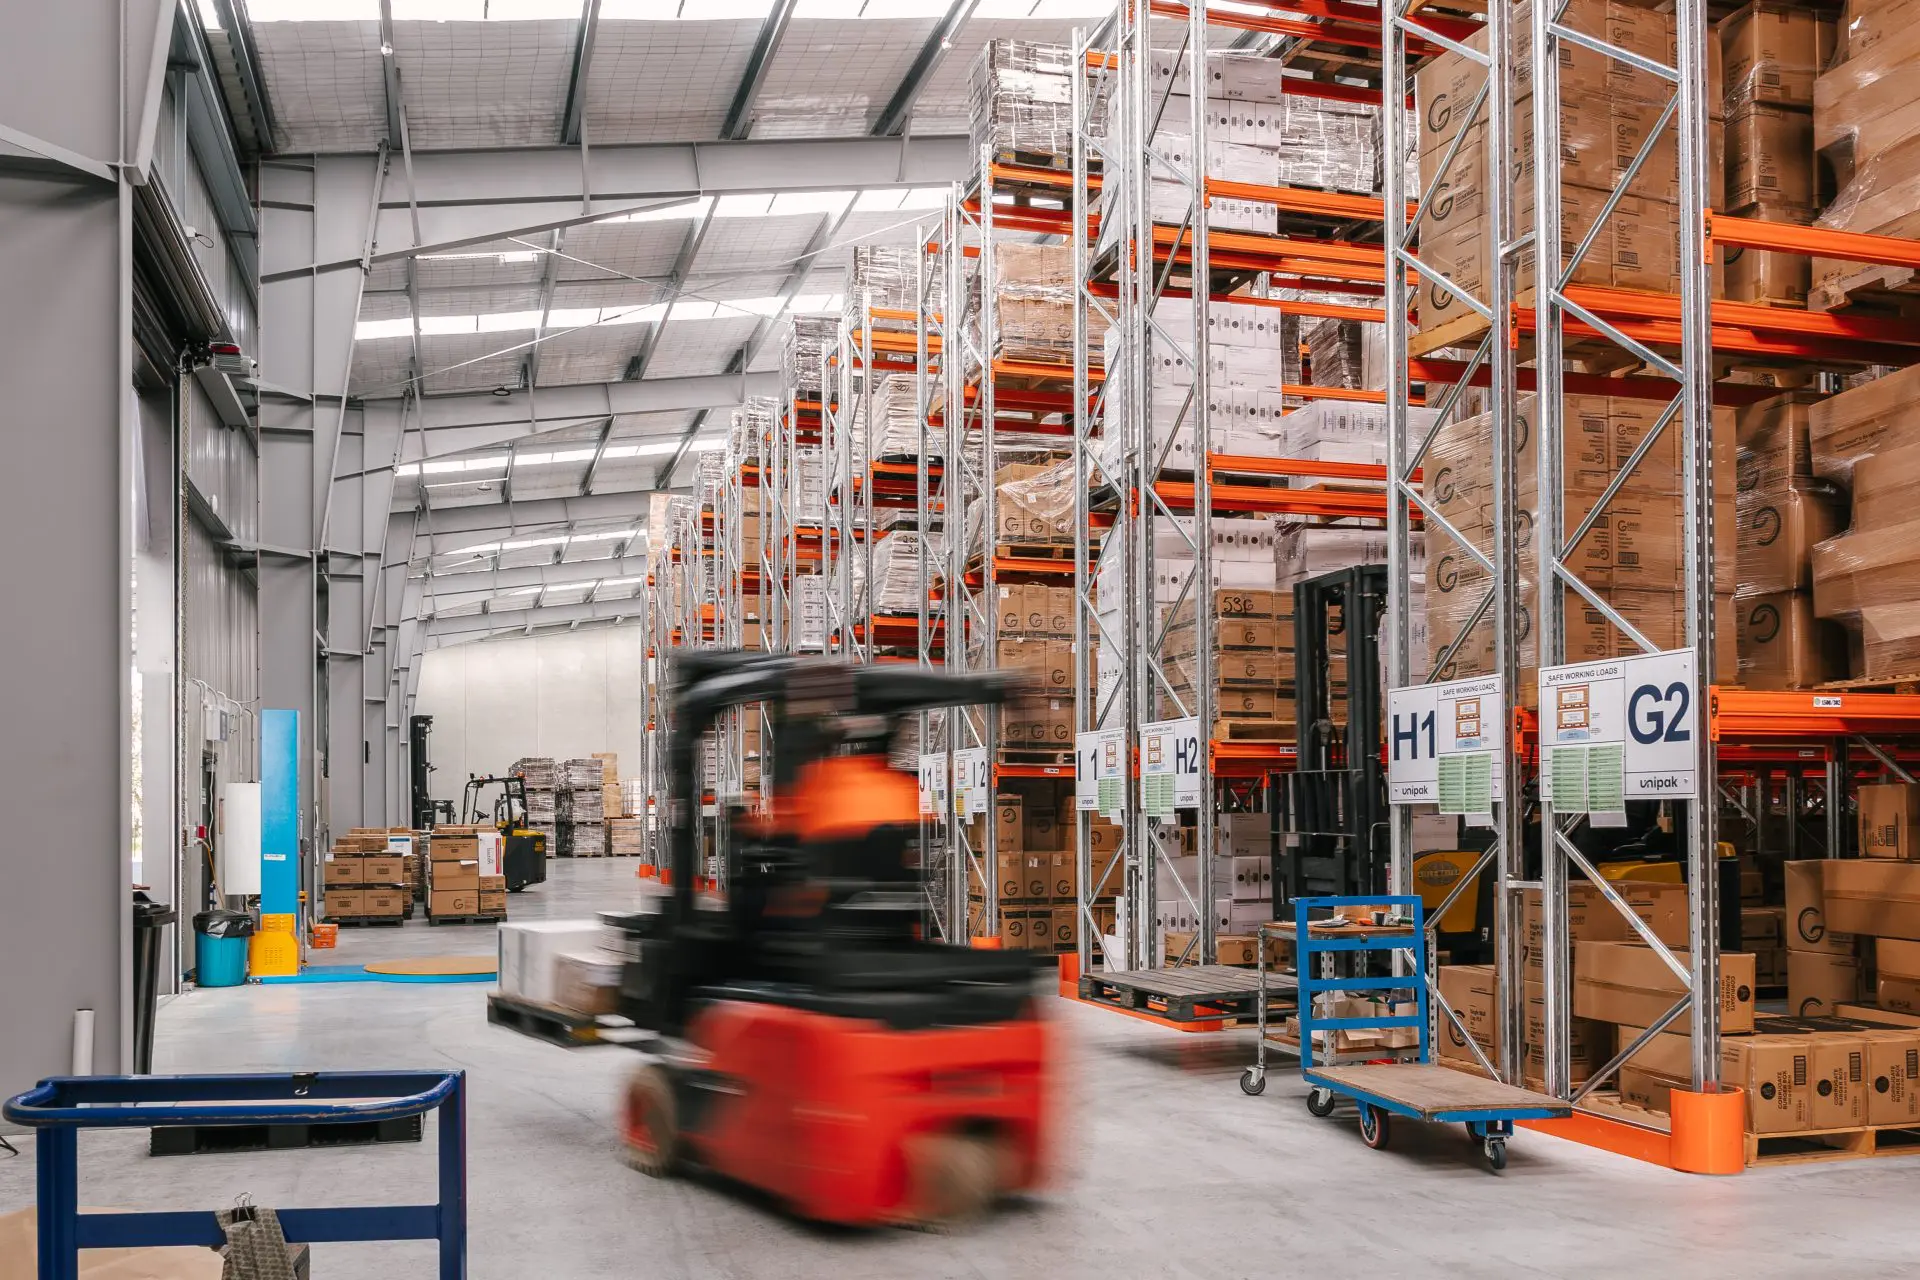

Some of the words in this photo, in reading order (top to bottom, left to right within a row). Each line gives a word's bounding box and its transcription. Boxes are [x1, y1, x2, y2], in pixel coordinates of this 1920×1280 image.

[1565, 670, 1594, 680] WORKING
[1596, 667, 1618, 676] LOADS
[1456, 686, 1478, 694] WORKING
[1628, 682, 1690, 744] G2
[1394, 710, 1435, 760] H1
[1176, 737, 1198, 774] H2
[1640, 776, 1678, 790] unipak
[1402, 785, 1428, 796] unipak
